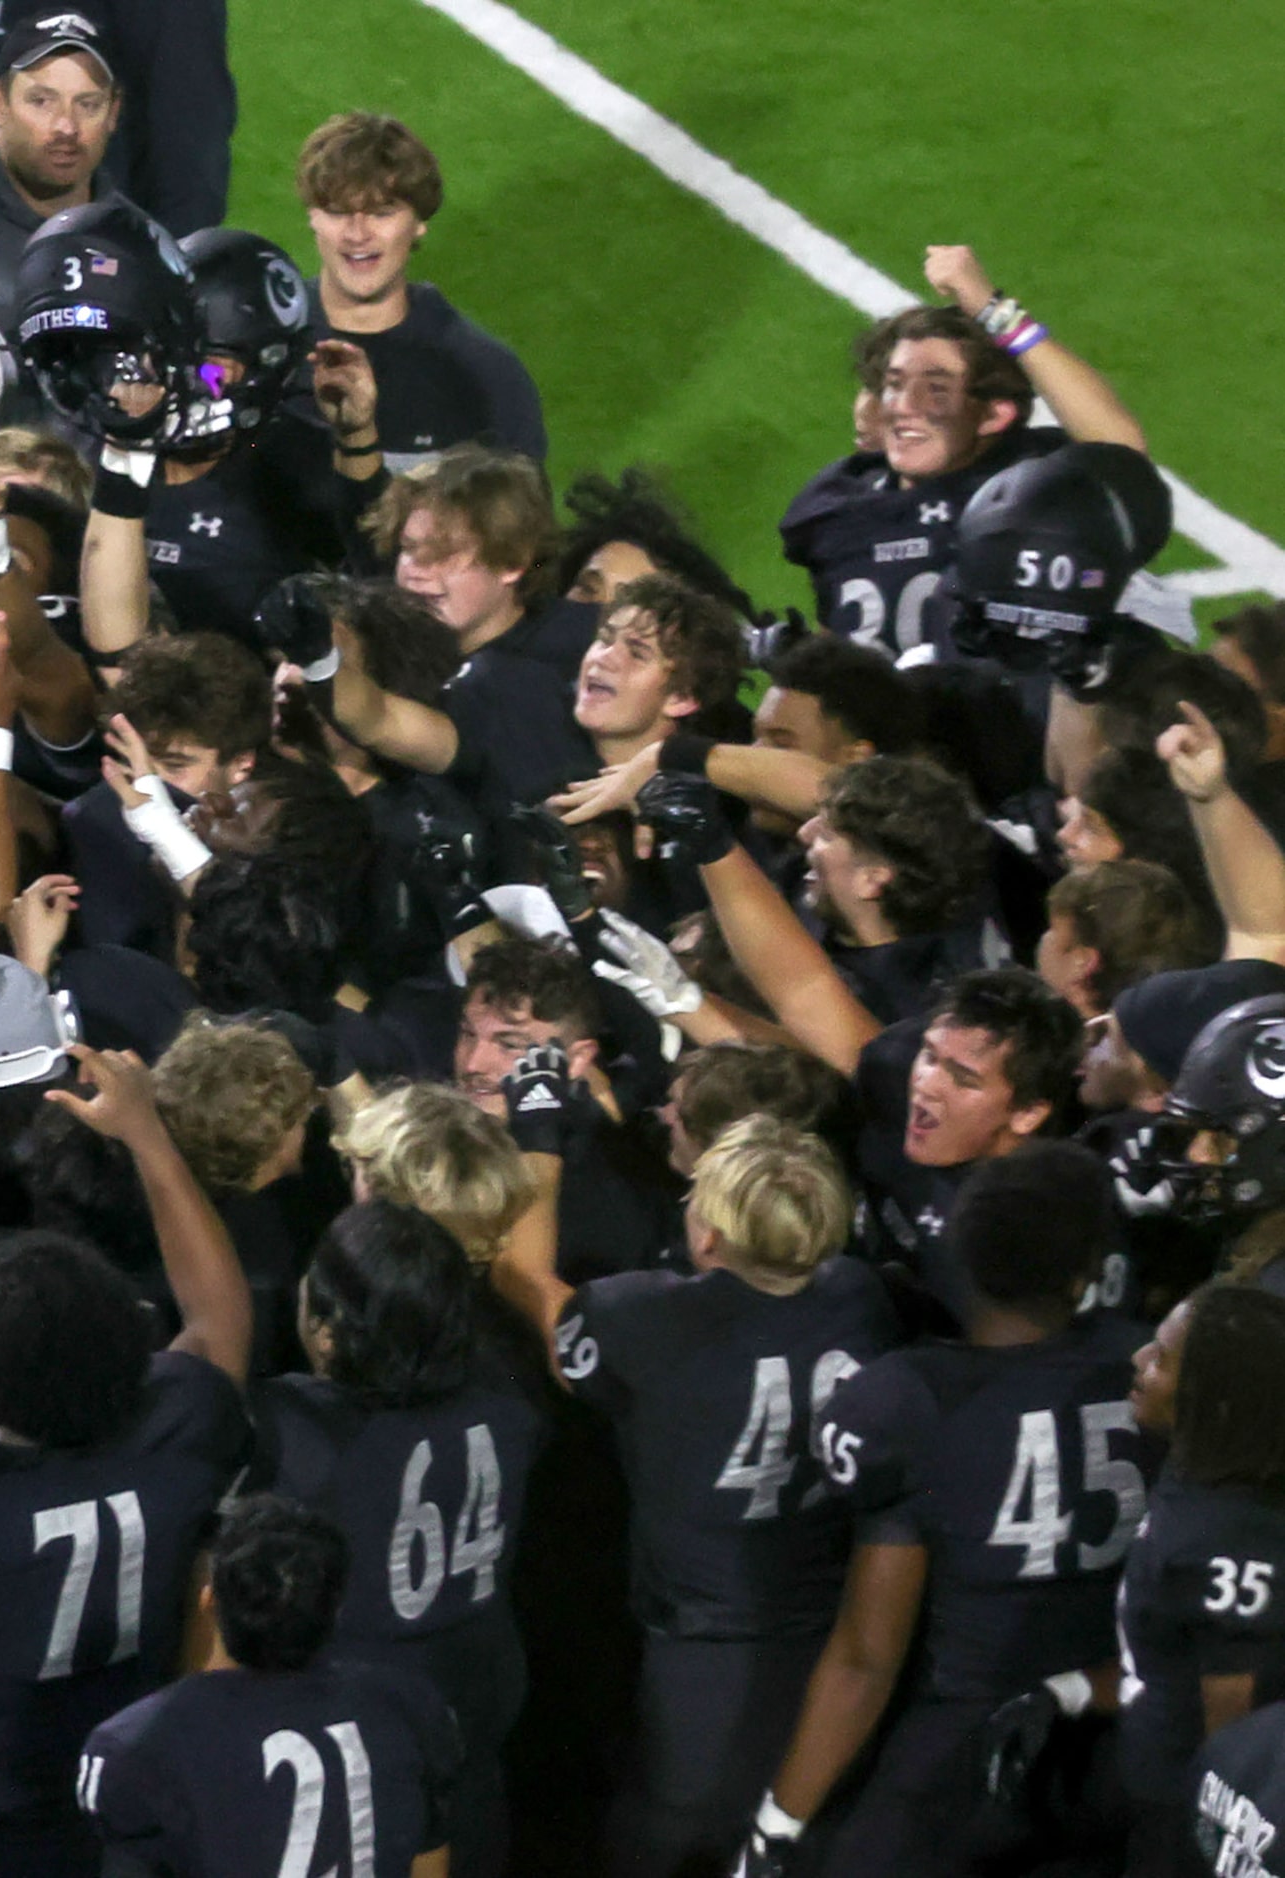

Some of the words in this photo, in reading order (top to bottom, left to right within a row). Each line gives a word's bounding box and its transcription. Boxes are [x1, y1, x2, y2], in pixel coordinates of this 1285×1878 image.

[19, 304, 109, 342] SOUTHSDE
[63, 256, 83, 291] 3
[1015, 550, 1074, 591] 50
[388, 1424, 505, 1620] 64
[986, 1400, 1147, 1577] 45
[32, 1490, 146, 1681] 71
[1203, 1556, 1274, 1616] 35
[262, 1720, 376, 1878] 21
